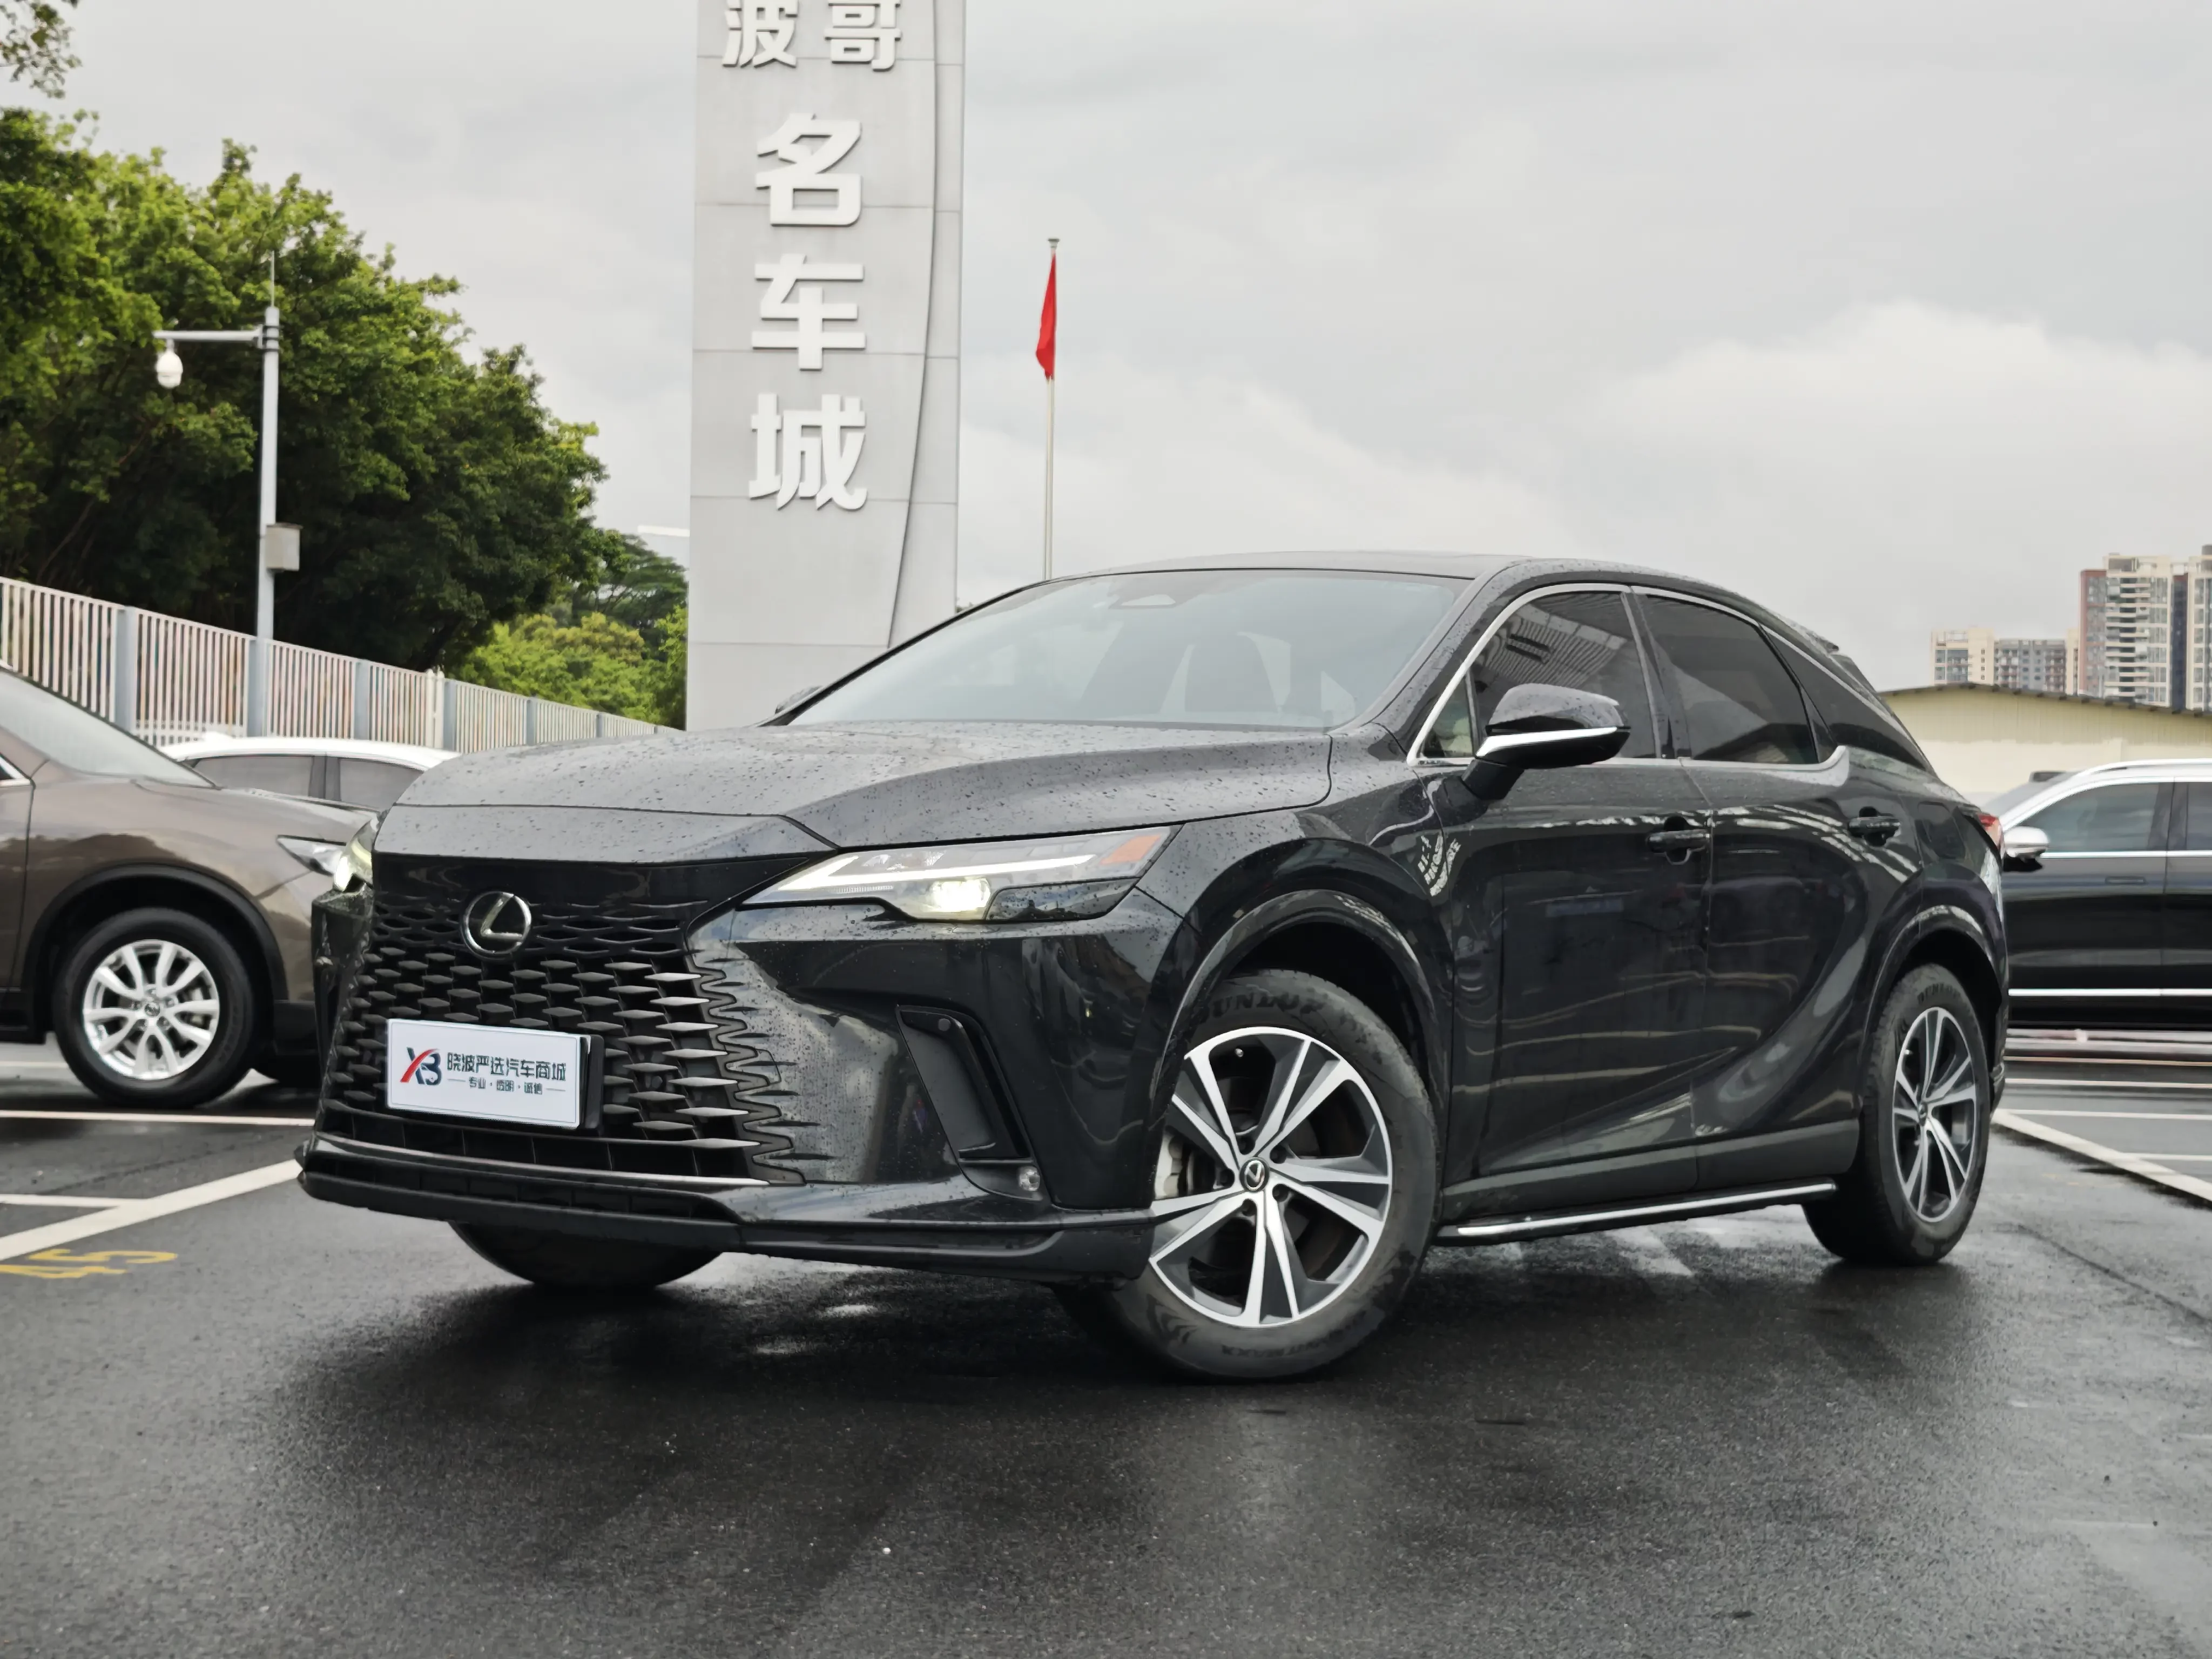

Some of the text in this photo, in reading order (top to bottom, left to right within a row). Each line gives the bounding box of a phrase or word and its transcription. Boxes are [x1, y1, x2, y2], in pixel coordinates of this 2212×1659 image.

[721, 0, 902, 72] 波哥
[748, 113, 868, 510] 名车城
[447, 1053, 566, 1081] 晓波严选汽车商城
